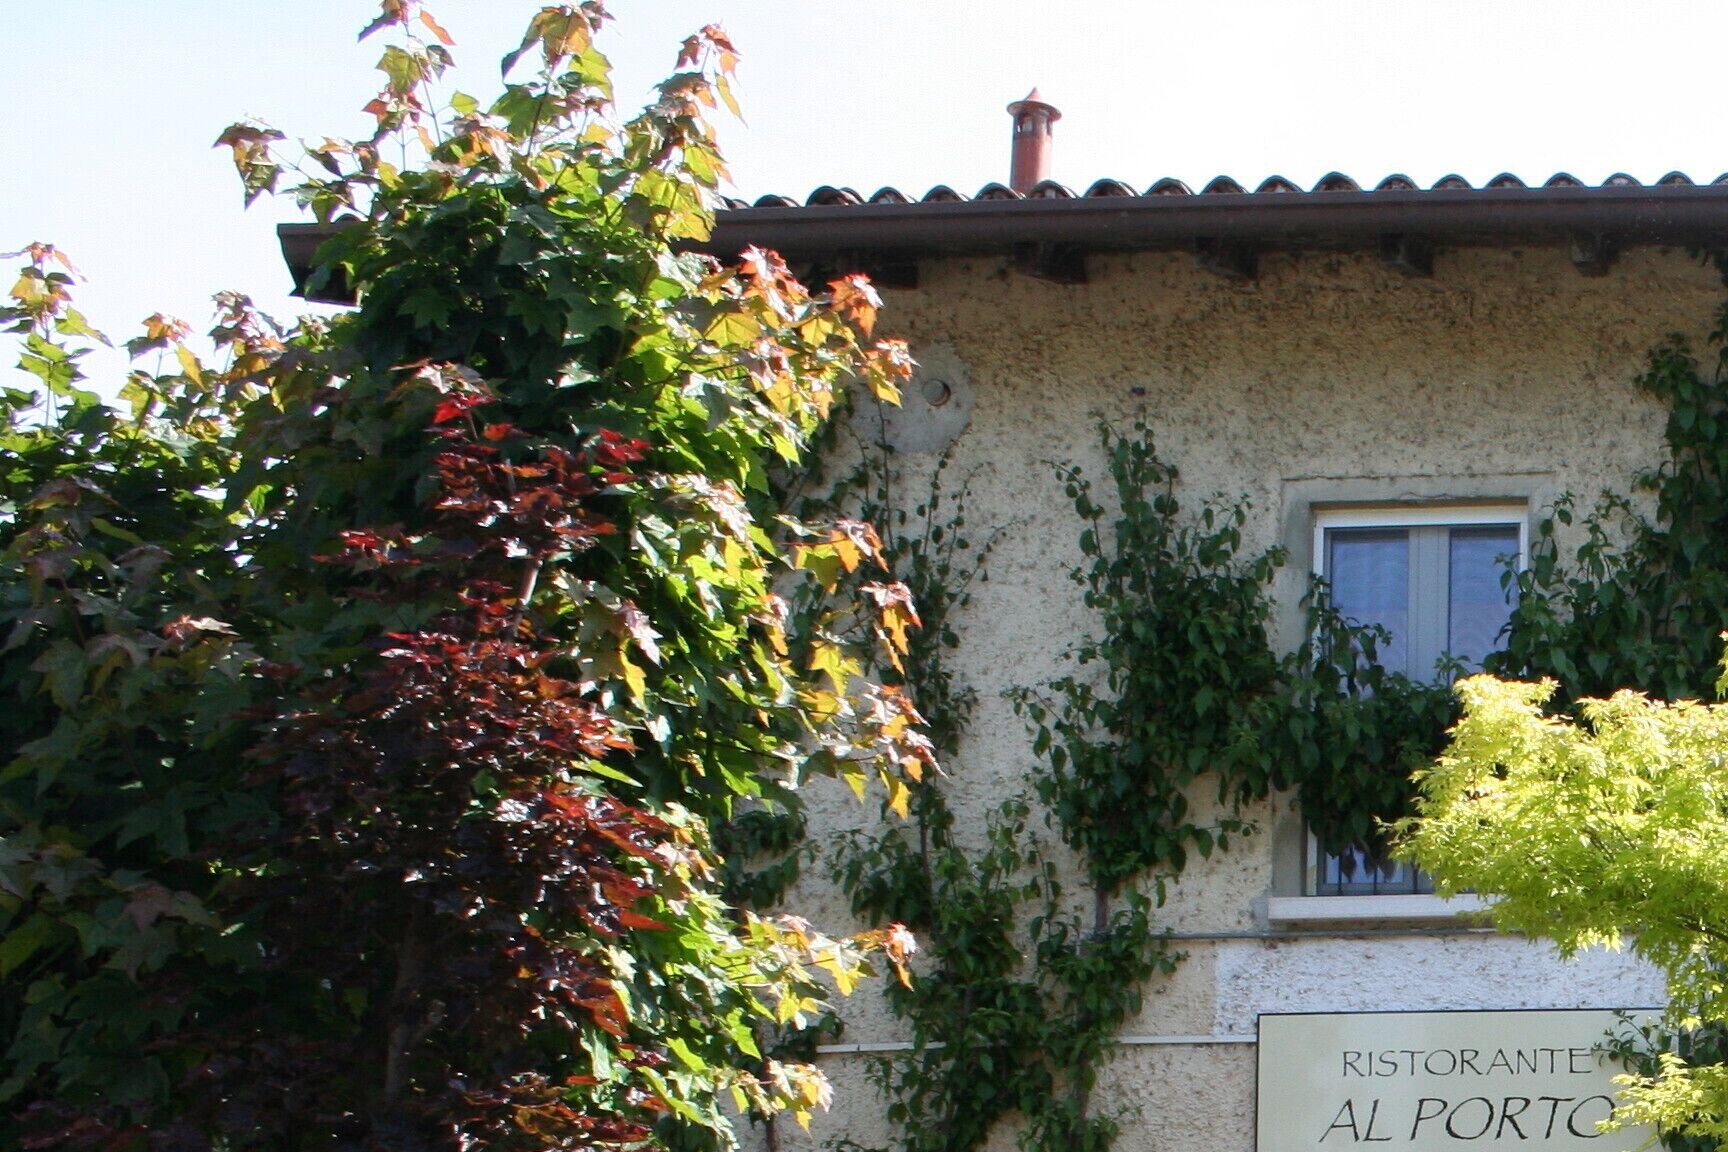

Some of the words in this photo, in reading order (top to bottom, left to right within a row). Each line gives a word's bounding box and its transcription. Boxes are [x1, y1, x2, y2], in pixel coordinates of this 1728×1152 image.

[1342, 1047, 1593, 1077] RISTORANTE
[1318, 1098, 1392, 1143] AL
[1410, 1094, 1616, 1141] PORTO
